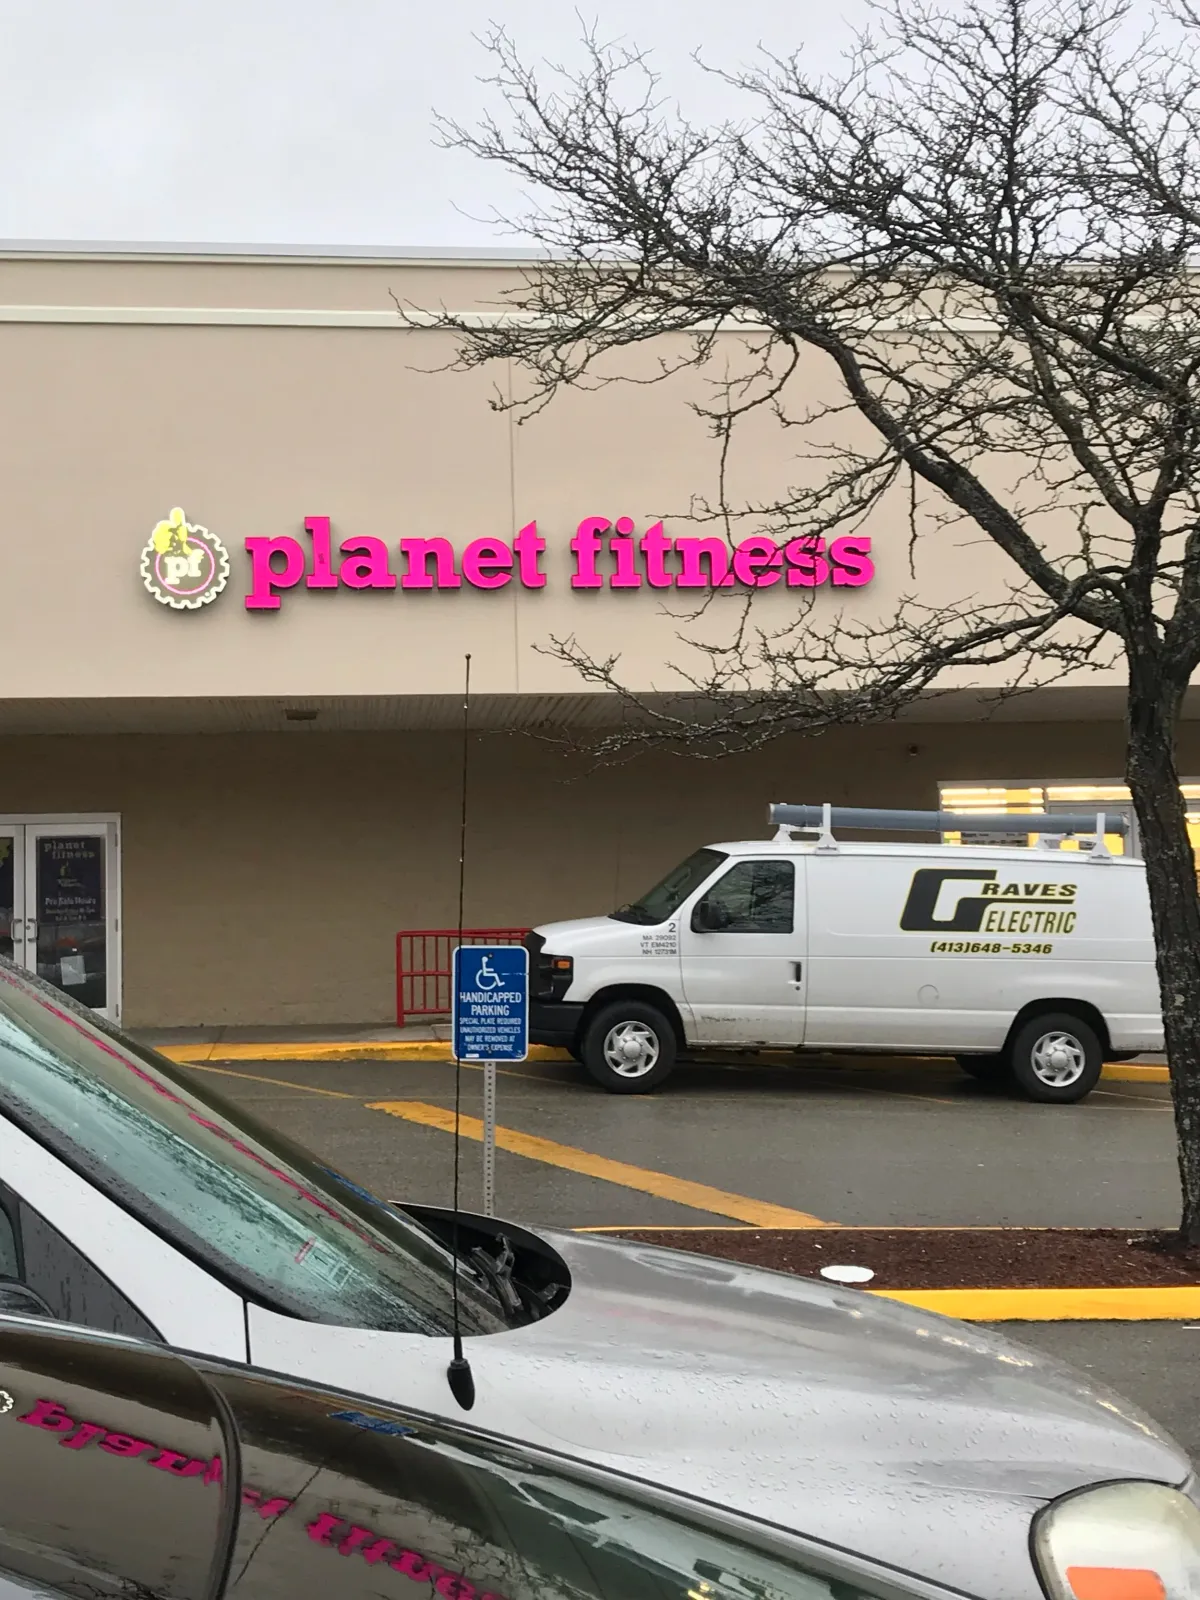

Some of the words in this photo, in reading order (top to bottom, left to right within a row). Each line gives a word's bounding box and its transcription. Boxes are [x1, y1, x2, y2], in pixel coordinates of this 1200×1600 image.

[164, 548, 205, 585] pf
[244, 516, 547, 609] planet
[570, 516, 875, 588] fitness
[668, 922, 677, 933] 2
[984, 910, 1077, 934] ELECTRIC
[930, 941, 1054, 955] (413)648-5346
[459, 991, 522, 1004] HANDICAPPED
[471, 1004, 510, 1017] PARKING
[459, 1017, 480, 1025] SPECIAL
[480, 1017, 496, 1025] PLATE
[496, 1017, 522, 1025] REQUIRED
[459, 1026, 497, 1034] UNAUTHORIZED
[497, 1026, 521, 1034] VEHICLES
[465, 1035, 476, 1043] MAY
[475, 1035, 484, 1043] BE
[484, 1035, 508, 1043] REMOVED
[508, 1035, 516, 1043] AT
[467, 1043, 490, 1052] OWNER'S
[490, 1043, 514, 1052] EXPENSE
